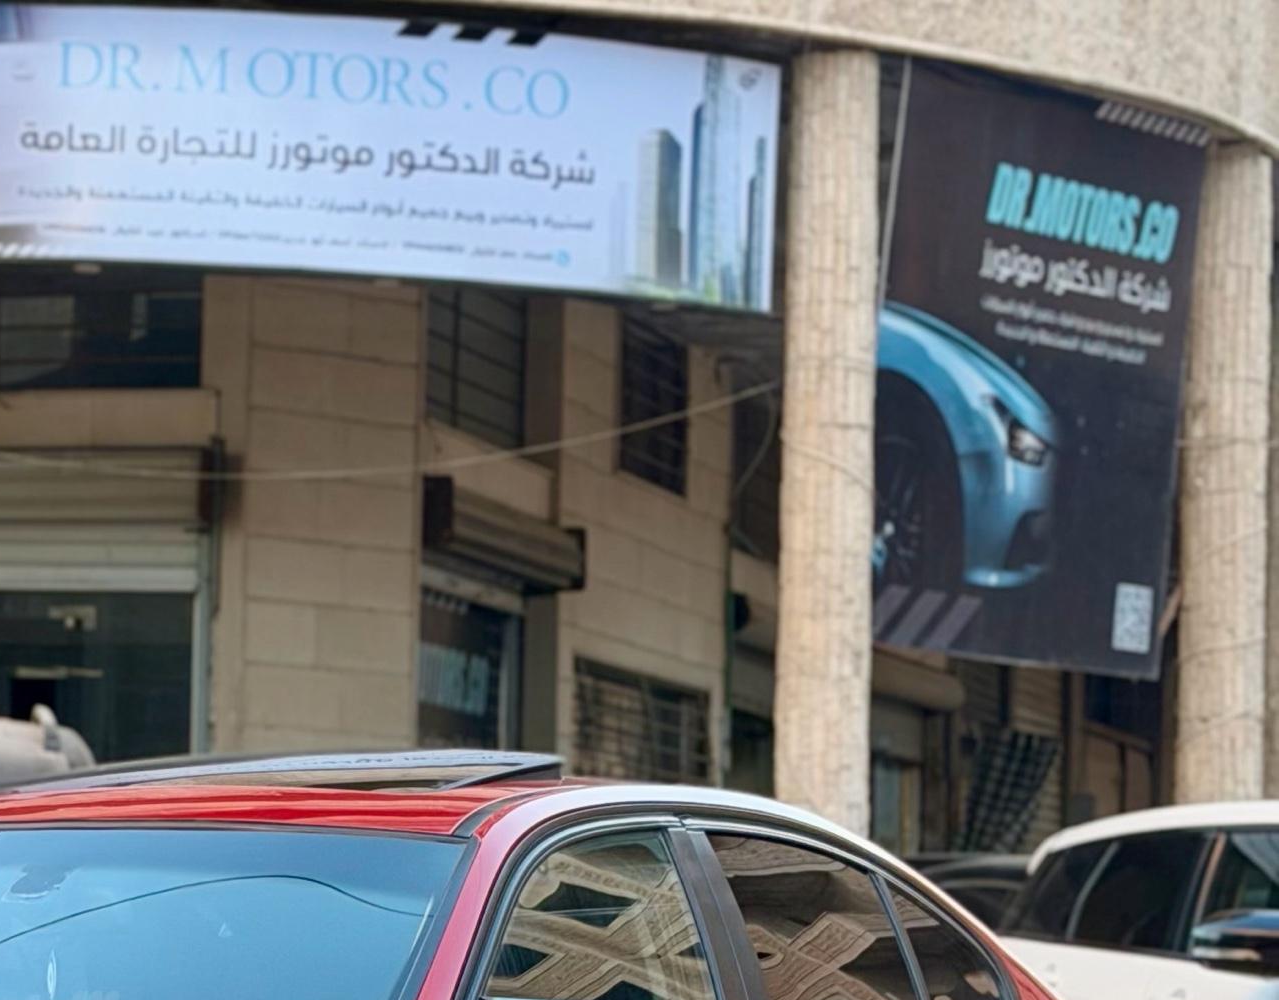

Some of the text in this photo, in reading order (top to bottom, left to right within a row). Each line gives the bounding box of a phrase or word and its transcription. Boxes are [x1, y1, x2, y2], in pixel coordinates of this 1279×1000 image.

[20, 121, 595, 190] شركة الدكتور موتورز للتجارة العامة
